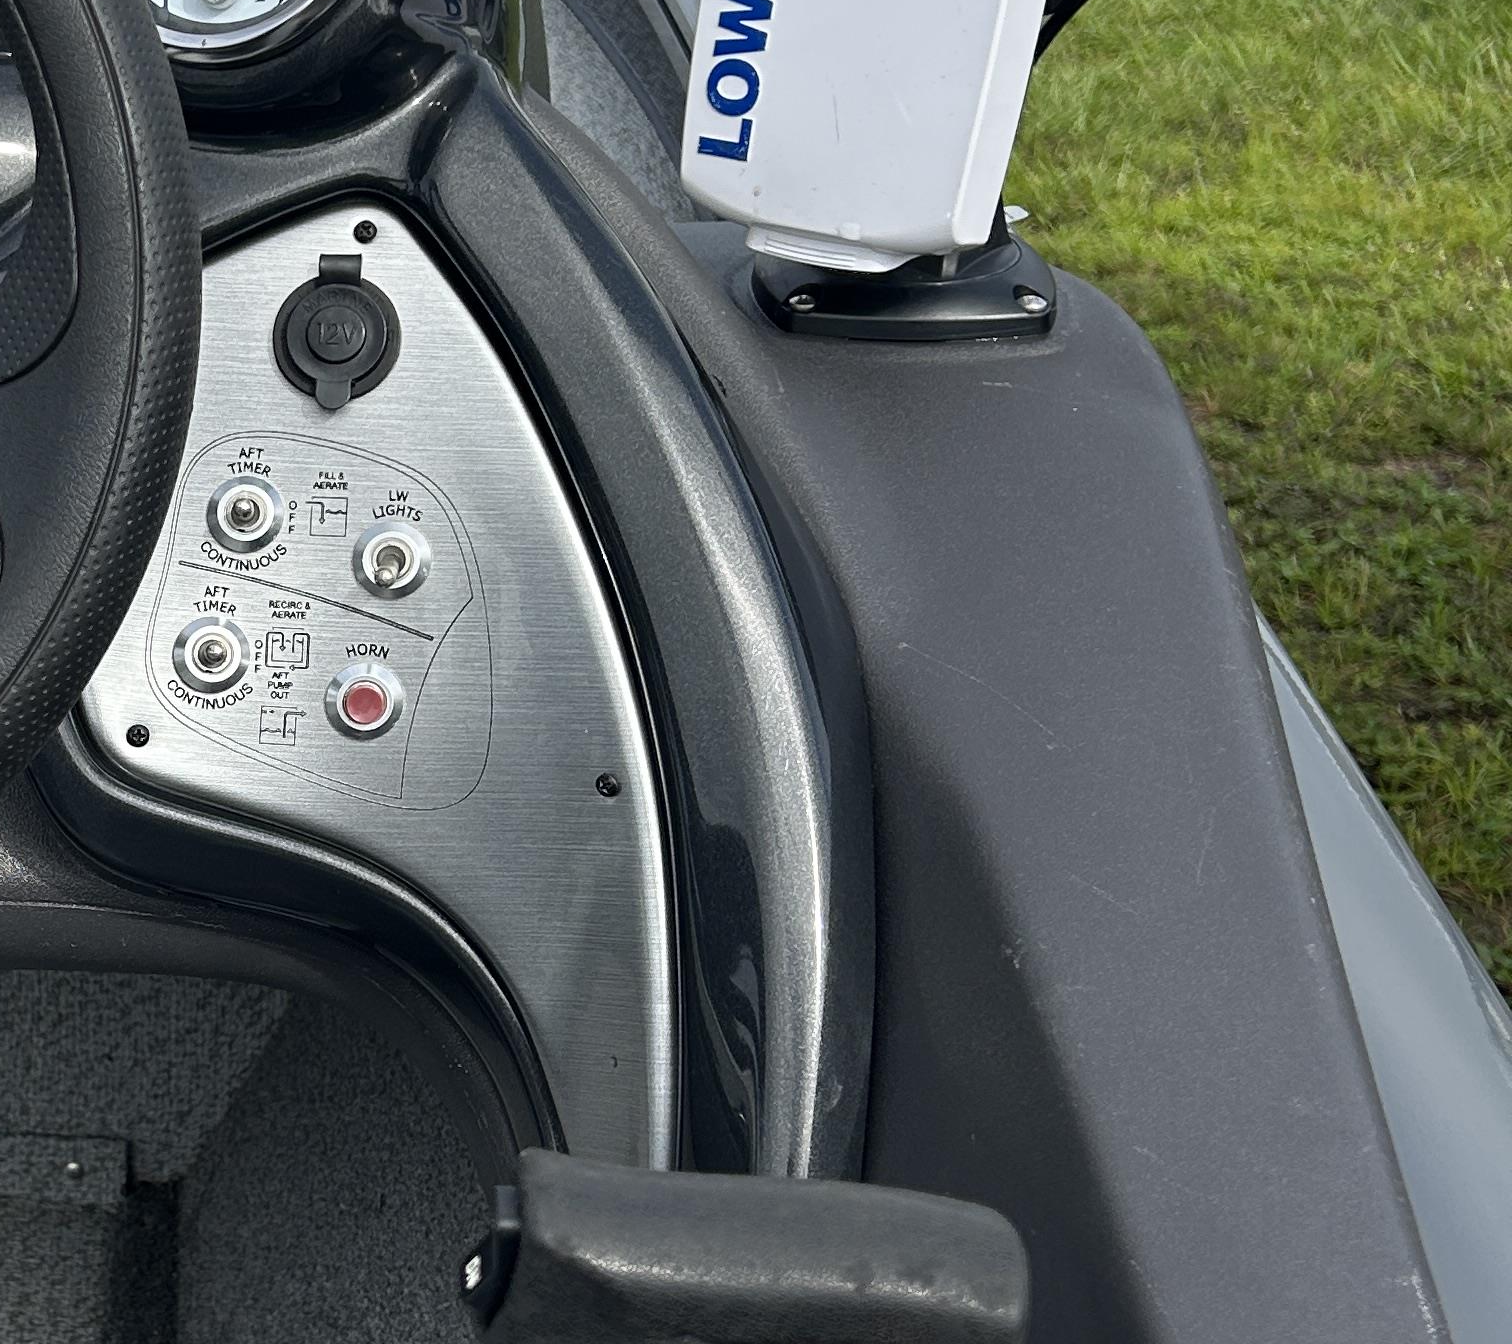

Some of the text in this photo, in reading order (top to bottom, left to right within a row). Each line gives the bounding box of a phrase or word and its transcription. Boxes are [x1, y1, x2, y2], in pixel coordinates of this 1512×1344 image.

[317, 322, 358, 346] 12V
[239, 447, 265, 460] AFT
[227, 461, 272, 478] TIMER
[318, 471, 336, 480] FILL
[313, 482, 349, 491] AERATE
[388, 489, 409, 503] LW
[372, 504, 423, 522] LIGHTS
[200, 541, 288, 571] CONTINUOUS
[204, 585, 230, 598] AFT
[193, 600, 237, 617] TIMER
[268, 599, 303, 610] RECIRC
[271, 611, 307, 619] AERATE
[345, 643, 390, 660] HORN
[271, 672, 290, 680] AFT
[267, 681, 294, 689] PUMP
[167, 679, 254, 710] CONTINUOUS
[270, 691, 291, 700] OUT
